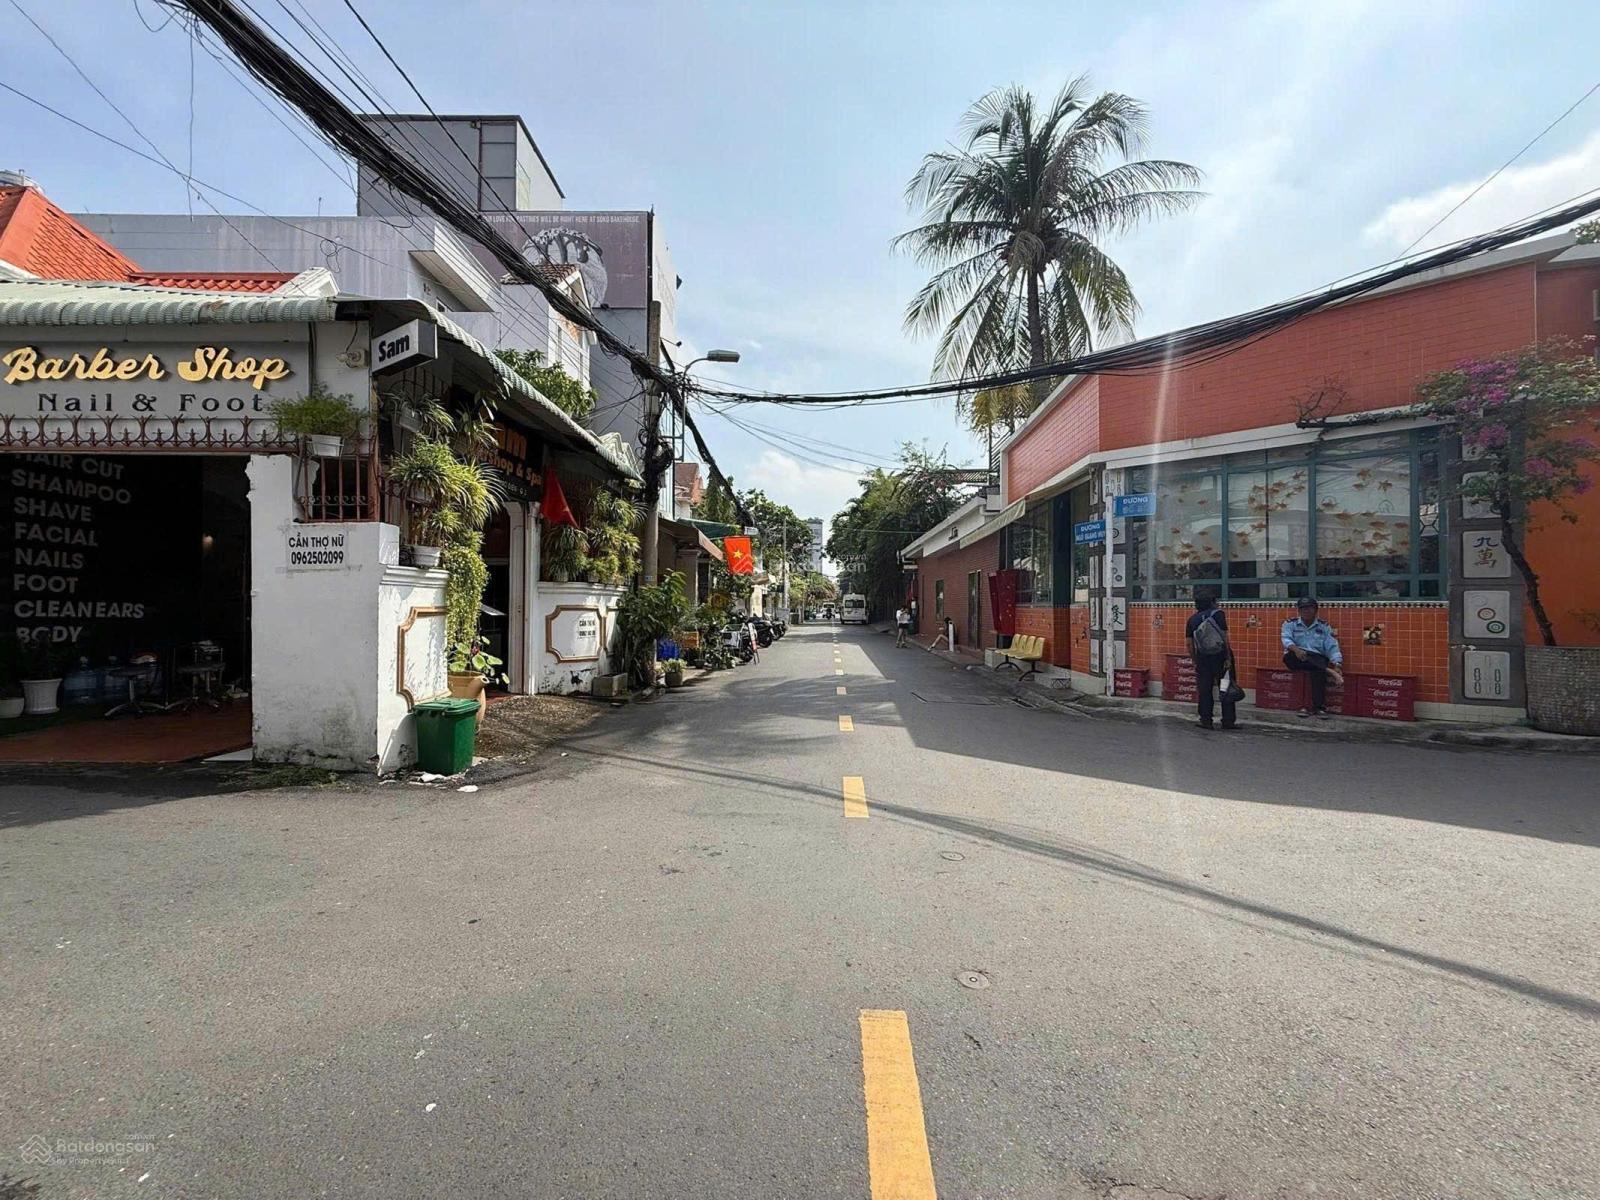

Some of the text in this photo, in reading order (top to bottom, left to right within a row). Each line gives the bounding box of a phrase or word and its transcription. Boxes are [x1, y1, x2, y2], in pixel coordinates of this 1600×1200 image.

[379, 335, 409, 362] Sam
[2, 346, 289, 390] Barber Shop
[38, 393, 264, 412] Nail & Foot
[81, 458, 124, 480] CUT
[11, 469, 132, 504] SHAMPOO
[14, 496, 93, 522] SHAVE
[14, 521, 99, 547] FACIAL
[289, 531, 344, 550] CẦN THỢ NỮ
[14, 547, 84, 569] NAILS
[291, 550, 344, 565] 0962502099
[13, 573, 79, 594] FOOT
